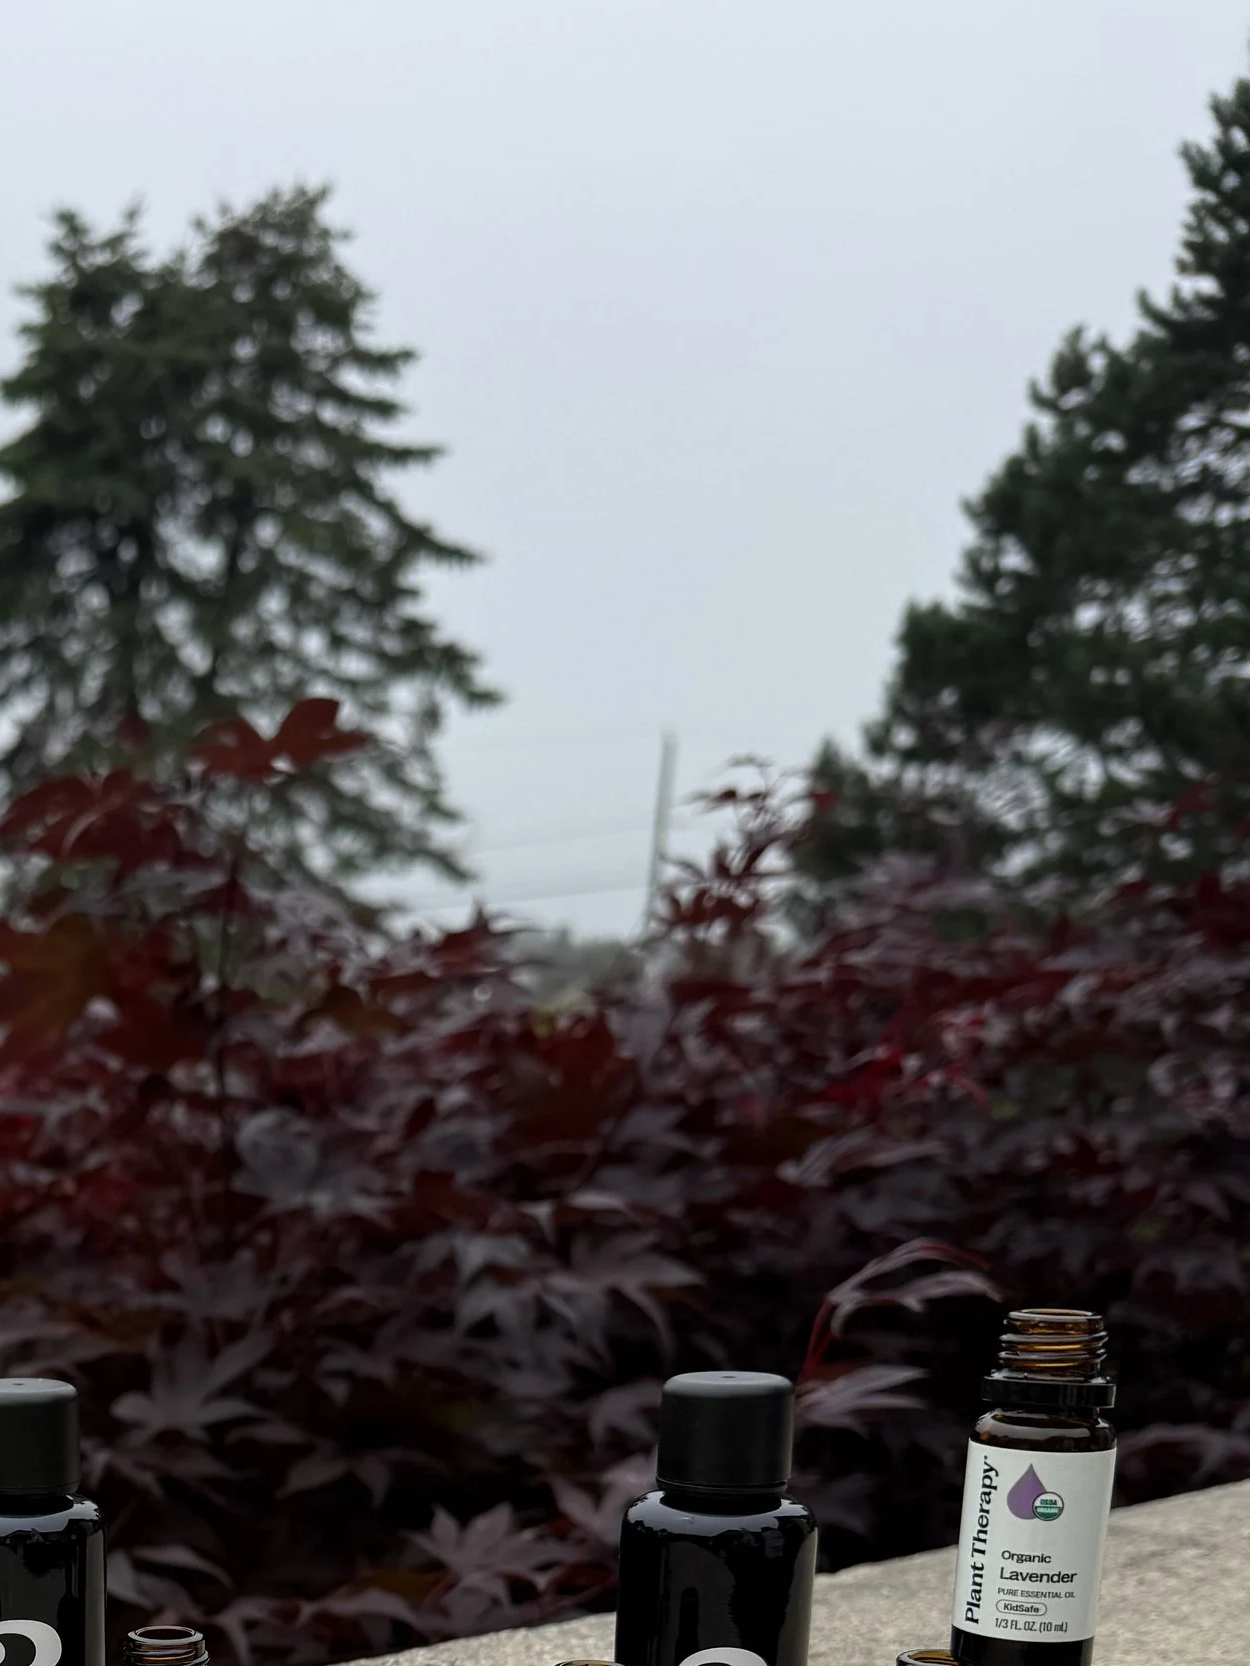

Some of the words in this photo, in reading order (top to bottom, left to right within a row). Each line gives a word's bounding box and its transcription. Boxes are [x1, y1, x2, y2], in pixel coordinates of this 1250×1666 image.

[971, 1460, 999, 1558] Therapy
[1001, 1550, 1052, 1564] Organic
[1000, 1567, 1077, 1583] Lavender
[965, 1561, 985, 1624] Plant
[997, 1588, 1019, 1597] PURE
[1020, 1590, 1063, 1599] ESSENTIAL
[1003, 1603, 1040, 1614] KidSafe
[995, 1618, 1009, 1629] 1/3
[1010, 1620, 1022, 1631] FL.
[1024, 1621, 1037, 1632] OZ.
[1039, 1621, 1052, 1633] (10
[1054, 1621, 1068, 1633] mL)
